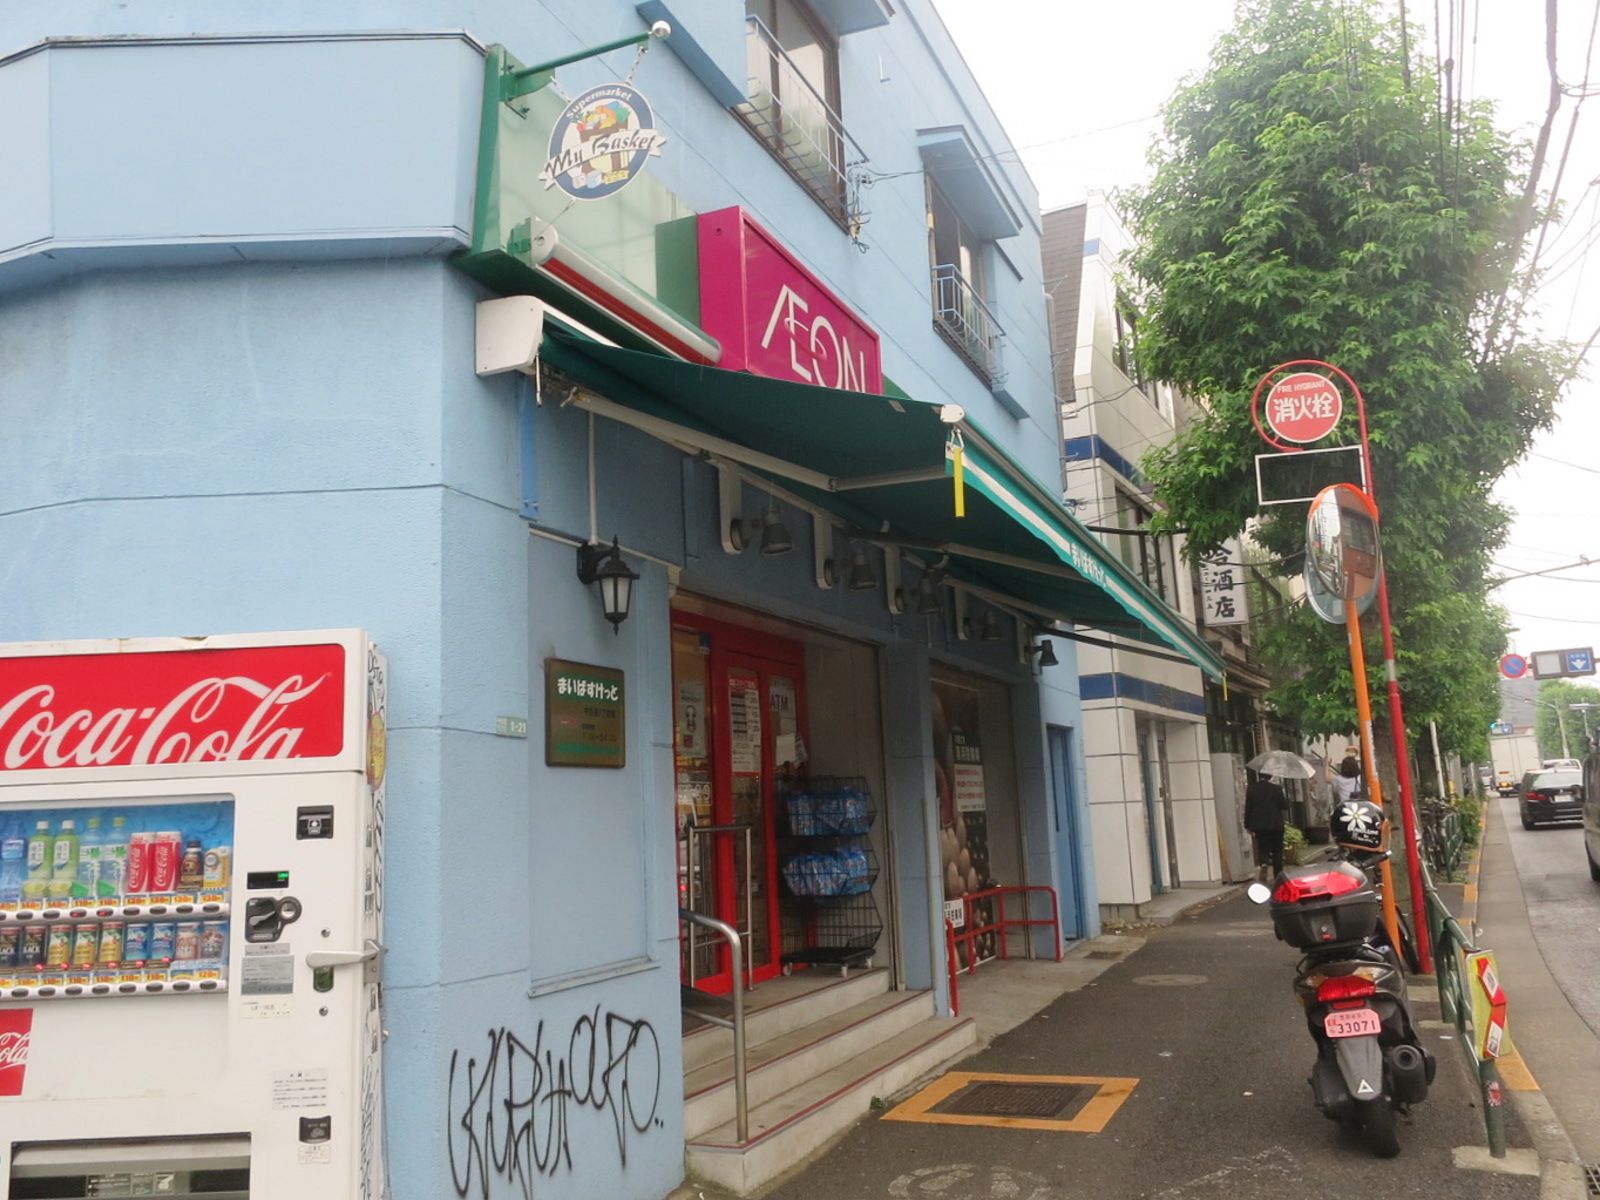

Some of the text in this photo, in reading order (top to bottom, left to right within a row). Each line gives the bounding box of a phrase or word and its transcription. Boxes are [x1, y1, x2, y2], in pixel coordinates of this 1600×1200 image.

[567, 88, 632, 119] Supermarket
[545, 130, 656, 177] My Basket
[1276, 384, 1293, 393] FIRE
[1273, 392, 1335, 423] 消火栓
[557, 677, 618, 701] まいばすけっと
[1338, 1020, 1376, 1034] 33071
